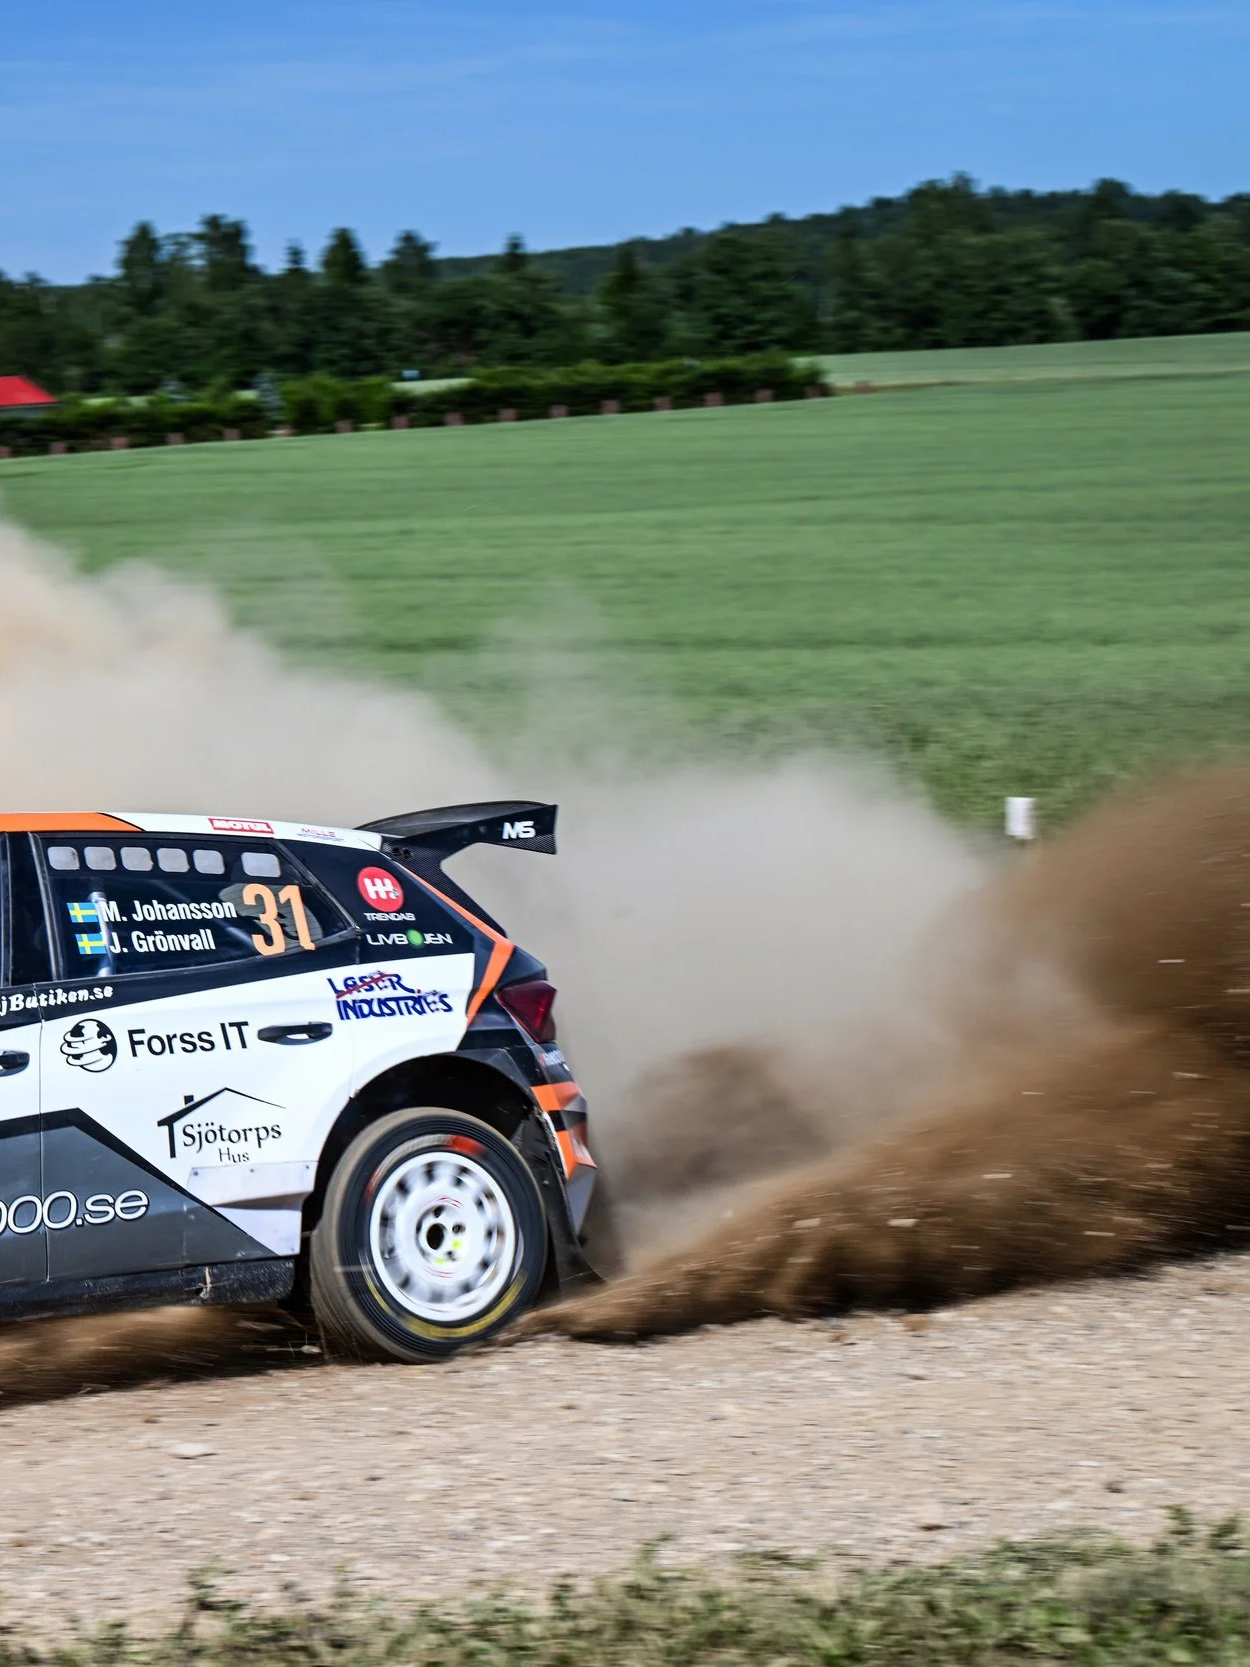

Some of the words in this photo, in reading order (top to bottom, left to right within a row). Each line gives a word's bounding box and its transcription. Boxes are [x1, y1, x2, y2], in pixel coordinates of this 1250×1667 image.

[212, 820, 271, 831] MOTUL
[101, 900, 128, 923] M.
[132, 900, 238, 922] Johansson
[242, 883, 316, 957] 31
[110, 932, 129, 954] J.
[131, 929, 216, 953] Grönvall
[336, 989, 453, 1021] INDUSTRIES
[127, 1028, 216, 1058] Forss
[219, 1020, 250, 1051] IT
[182, 1121, 282, 1153] Sjötorps
[218, 1147, 250, 1163] Hus
